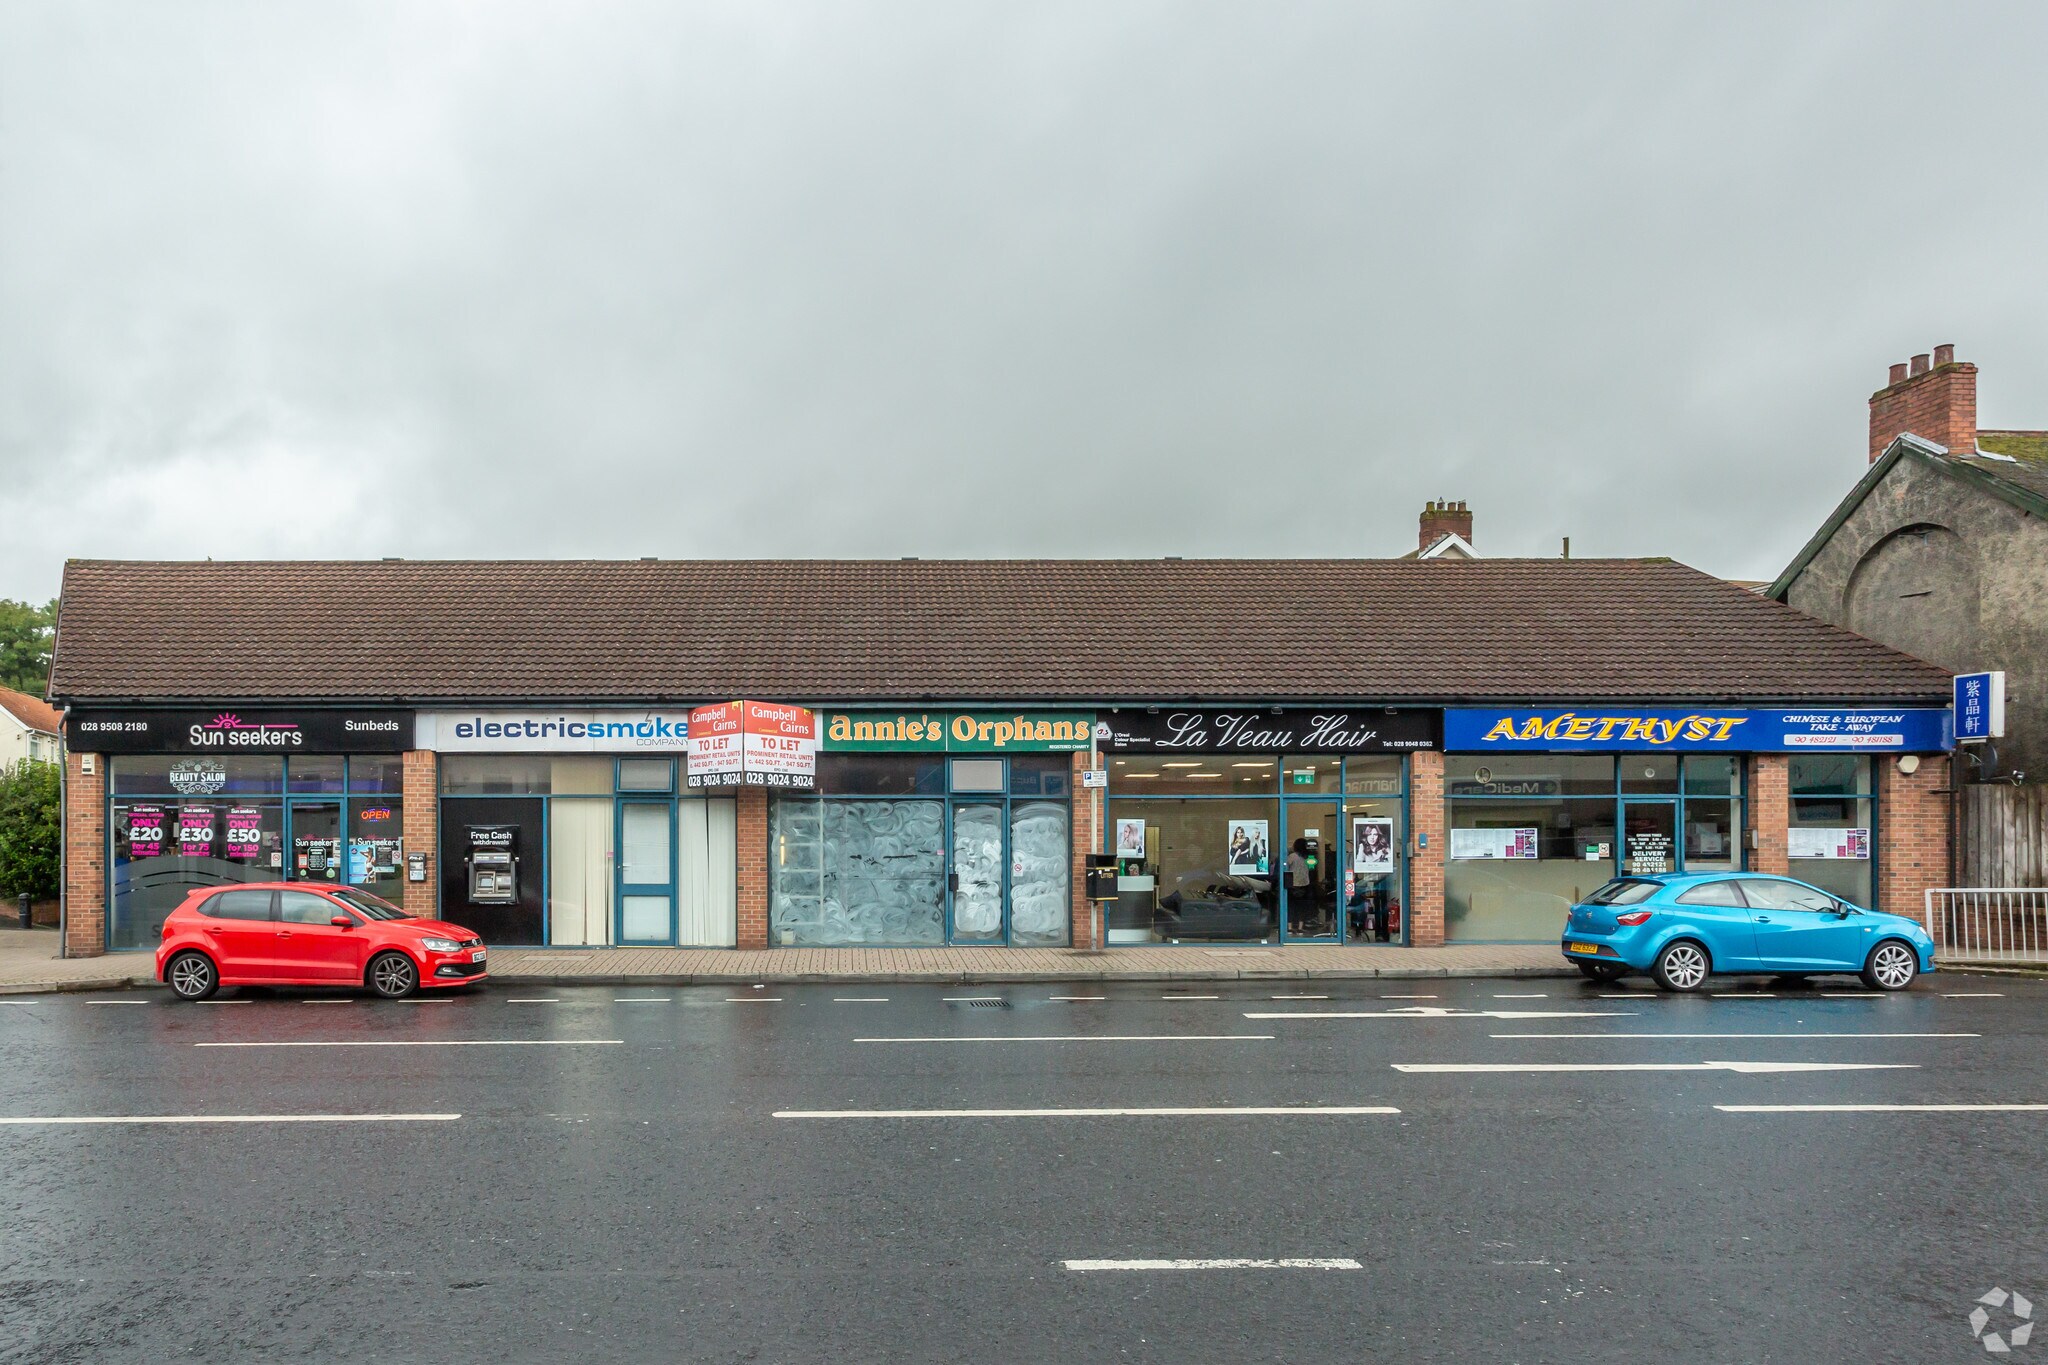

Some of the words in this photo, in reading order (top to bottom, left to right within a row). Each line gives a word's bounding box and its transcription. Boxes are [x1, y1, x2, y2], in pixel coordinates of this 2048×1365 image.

[1965, 680, 1980, 734] 紫晶軒
[692, 707, 726, 723] Campbell
[751, 706, 797, 722] Campbell
[1782, 715, 1831, 723] CHINESE
[1832, 715, 1842, 723] &
[1844, 714, 1906, 723] EUROPEAN
[81, 722, 98, 731] 028
[100, 722, 123, 731] 9508
[125, 722, 148, 731] 2180
[345, 720, 399, 731] Sunbeds
[713, 719, 737, 732] Cairns
[780, 721, 809, 735] Cairns
[951, 715, 1090, 747] Orphans
[1155, 713, 1208, 747] La
[1215, 714, 1293, 747] Veau
[1300, 714, 1377, 747] Hair
[1481, 712, 1748, 744] AMETHYST
[1809, 723, 1838, 731] TAKE
[1845, 722, 1877, 732] AWAY
[189, 724, 224, 746] Sun
[228, 725, 303, 746] seekers
[636, 738, 689, 746] COMPANY
[699, 740, 710, 751] TO
[712, 738, 729, 750] LET
[761, 738, 776, 749] TO
[780, 740, 801, 751] LET
[689, 753, 711, 761] PROMINENT
[746, 750, 778, 759] PROMINENT
[779, 752, 798, 760] RETAIL
[169, 772, 198, 783] BEAUTY
[200, 772, 226, 783] SALON
[688, 775, 701, 787] 028
[703, 774, 721, 786] 9024
[722, 772, 741, 785] 9024
[746, 772, 764, 785] 028
[767, 774, 790, 786] 9024
[792, 775, 814, 787] 9024
[361, 810, 390, 820] OPEN
[131, 818, 160, 827] ONLY
[181, 819, 211, 828] ONLY
[229, 820, 257, 829] ONLY
[129, 826, 163, 841] £20
[180, 828, 214, 842] £30
[227, 828, 261, 842] £50
[470, 831, 490, 839] Free
[491, 831, 512, 839] Cash
[131, 842, 145, 850] for
[183, 843, 196, 851] for
[198, 843, 210, 851] 75
[295, 838, 309, 846] Sun
[357, 837, 370, 847] Sun
[227, 844, 241, 852] for
[243, 844, 259, 852] 150
